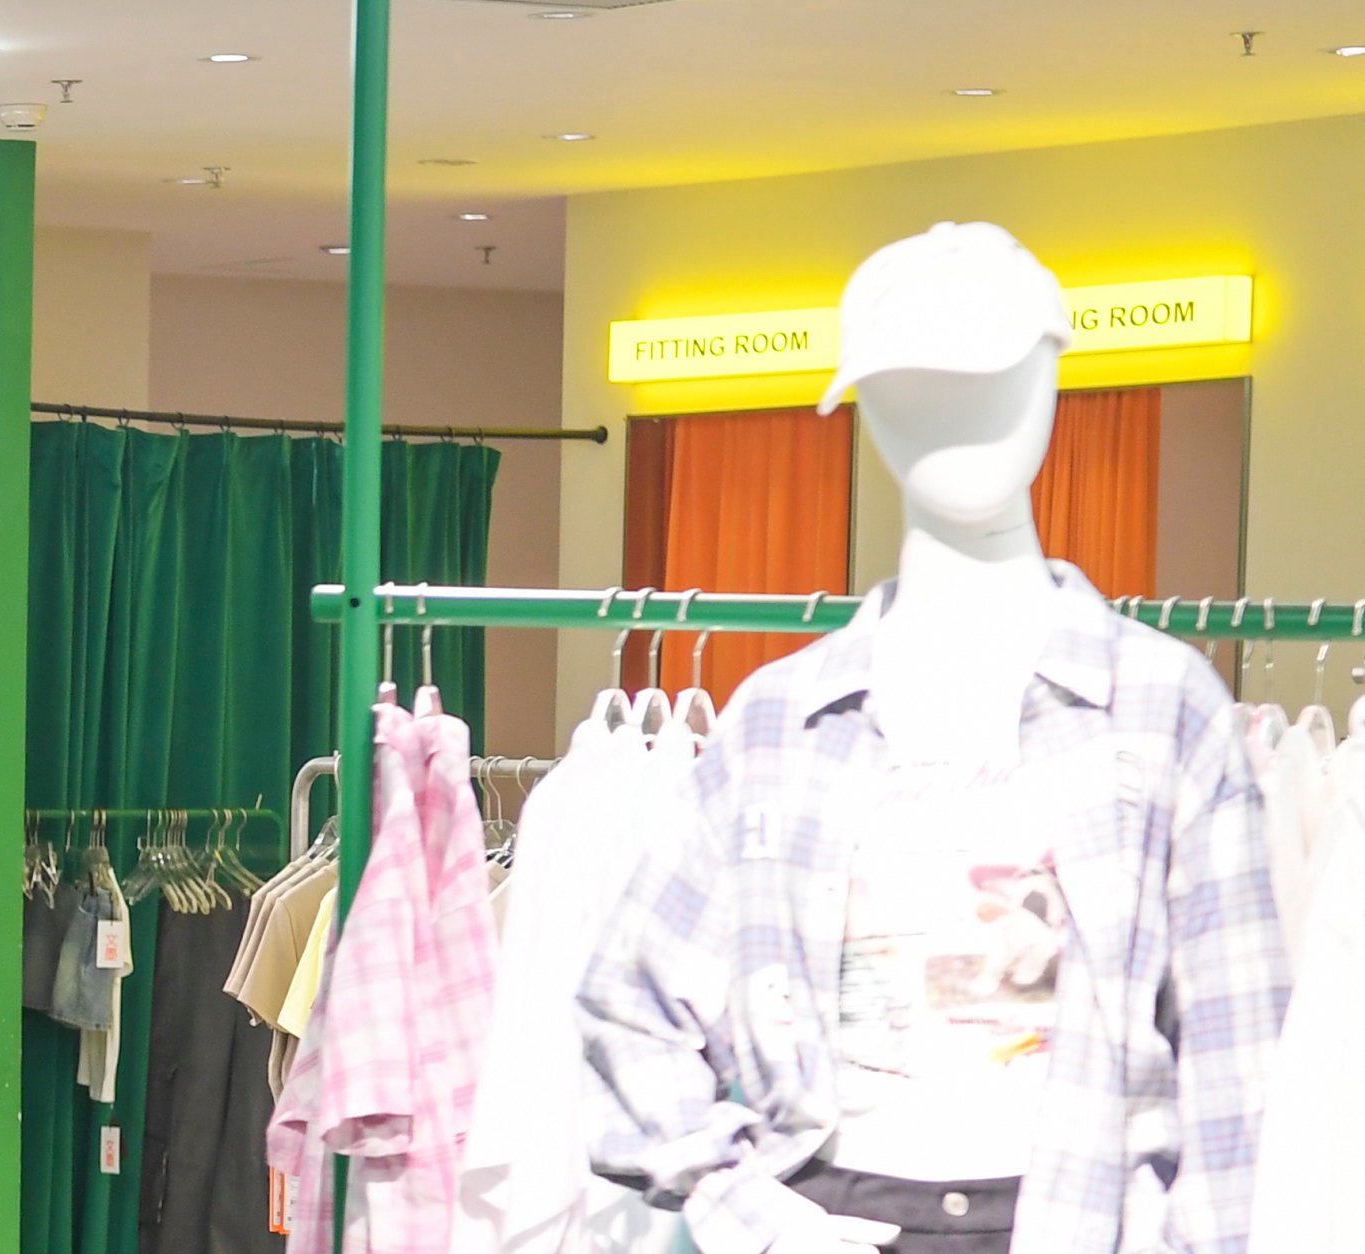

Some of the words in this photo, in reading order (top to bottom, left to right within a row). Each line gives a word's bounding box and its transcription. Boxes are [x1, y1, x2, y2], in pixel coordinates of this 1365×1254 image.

[1110, 302, 1194, 328] ROOM
[636, 336, 725, 361] FITTING
[735, 331, 809, 354] ROOM
